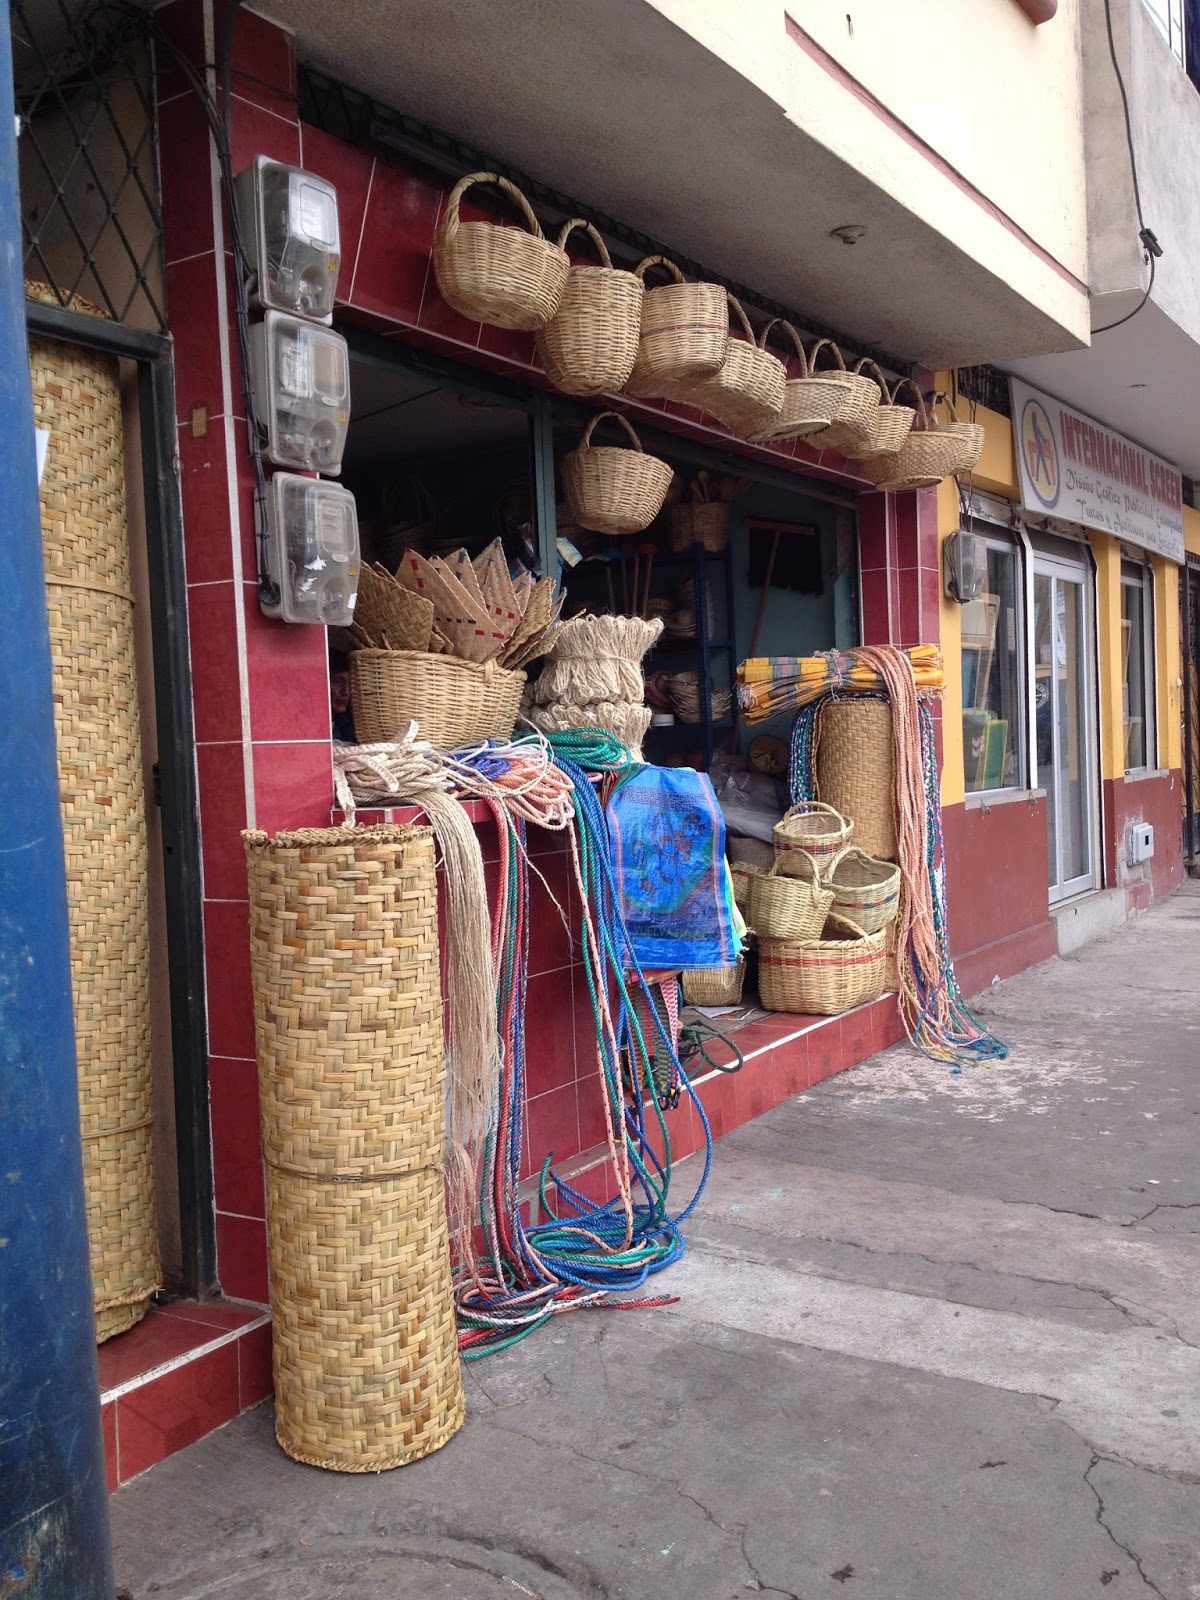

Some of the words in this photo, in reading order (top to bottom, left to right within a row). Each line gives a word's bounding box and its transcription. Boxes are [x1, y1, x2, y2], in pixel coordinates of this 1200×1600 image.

[1059, 410, 1149, 496] INTERNACIONAL
[1149, 459, 1181, 511] SCREEN
[1105, 515, 1112, 530] y
